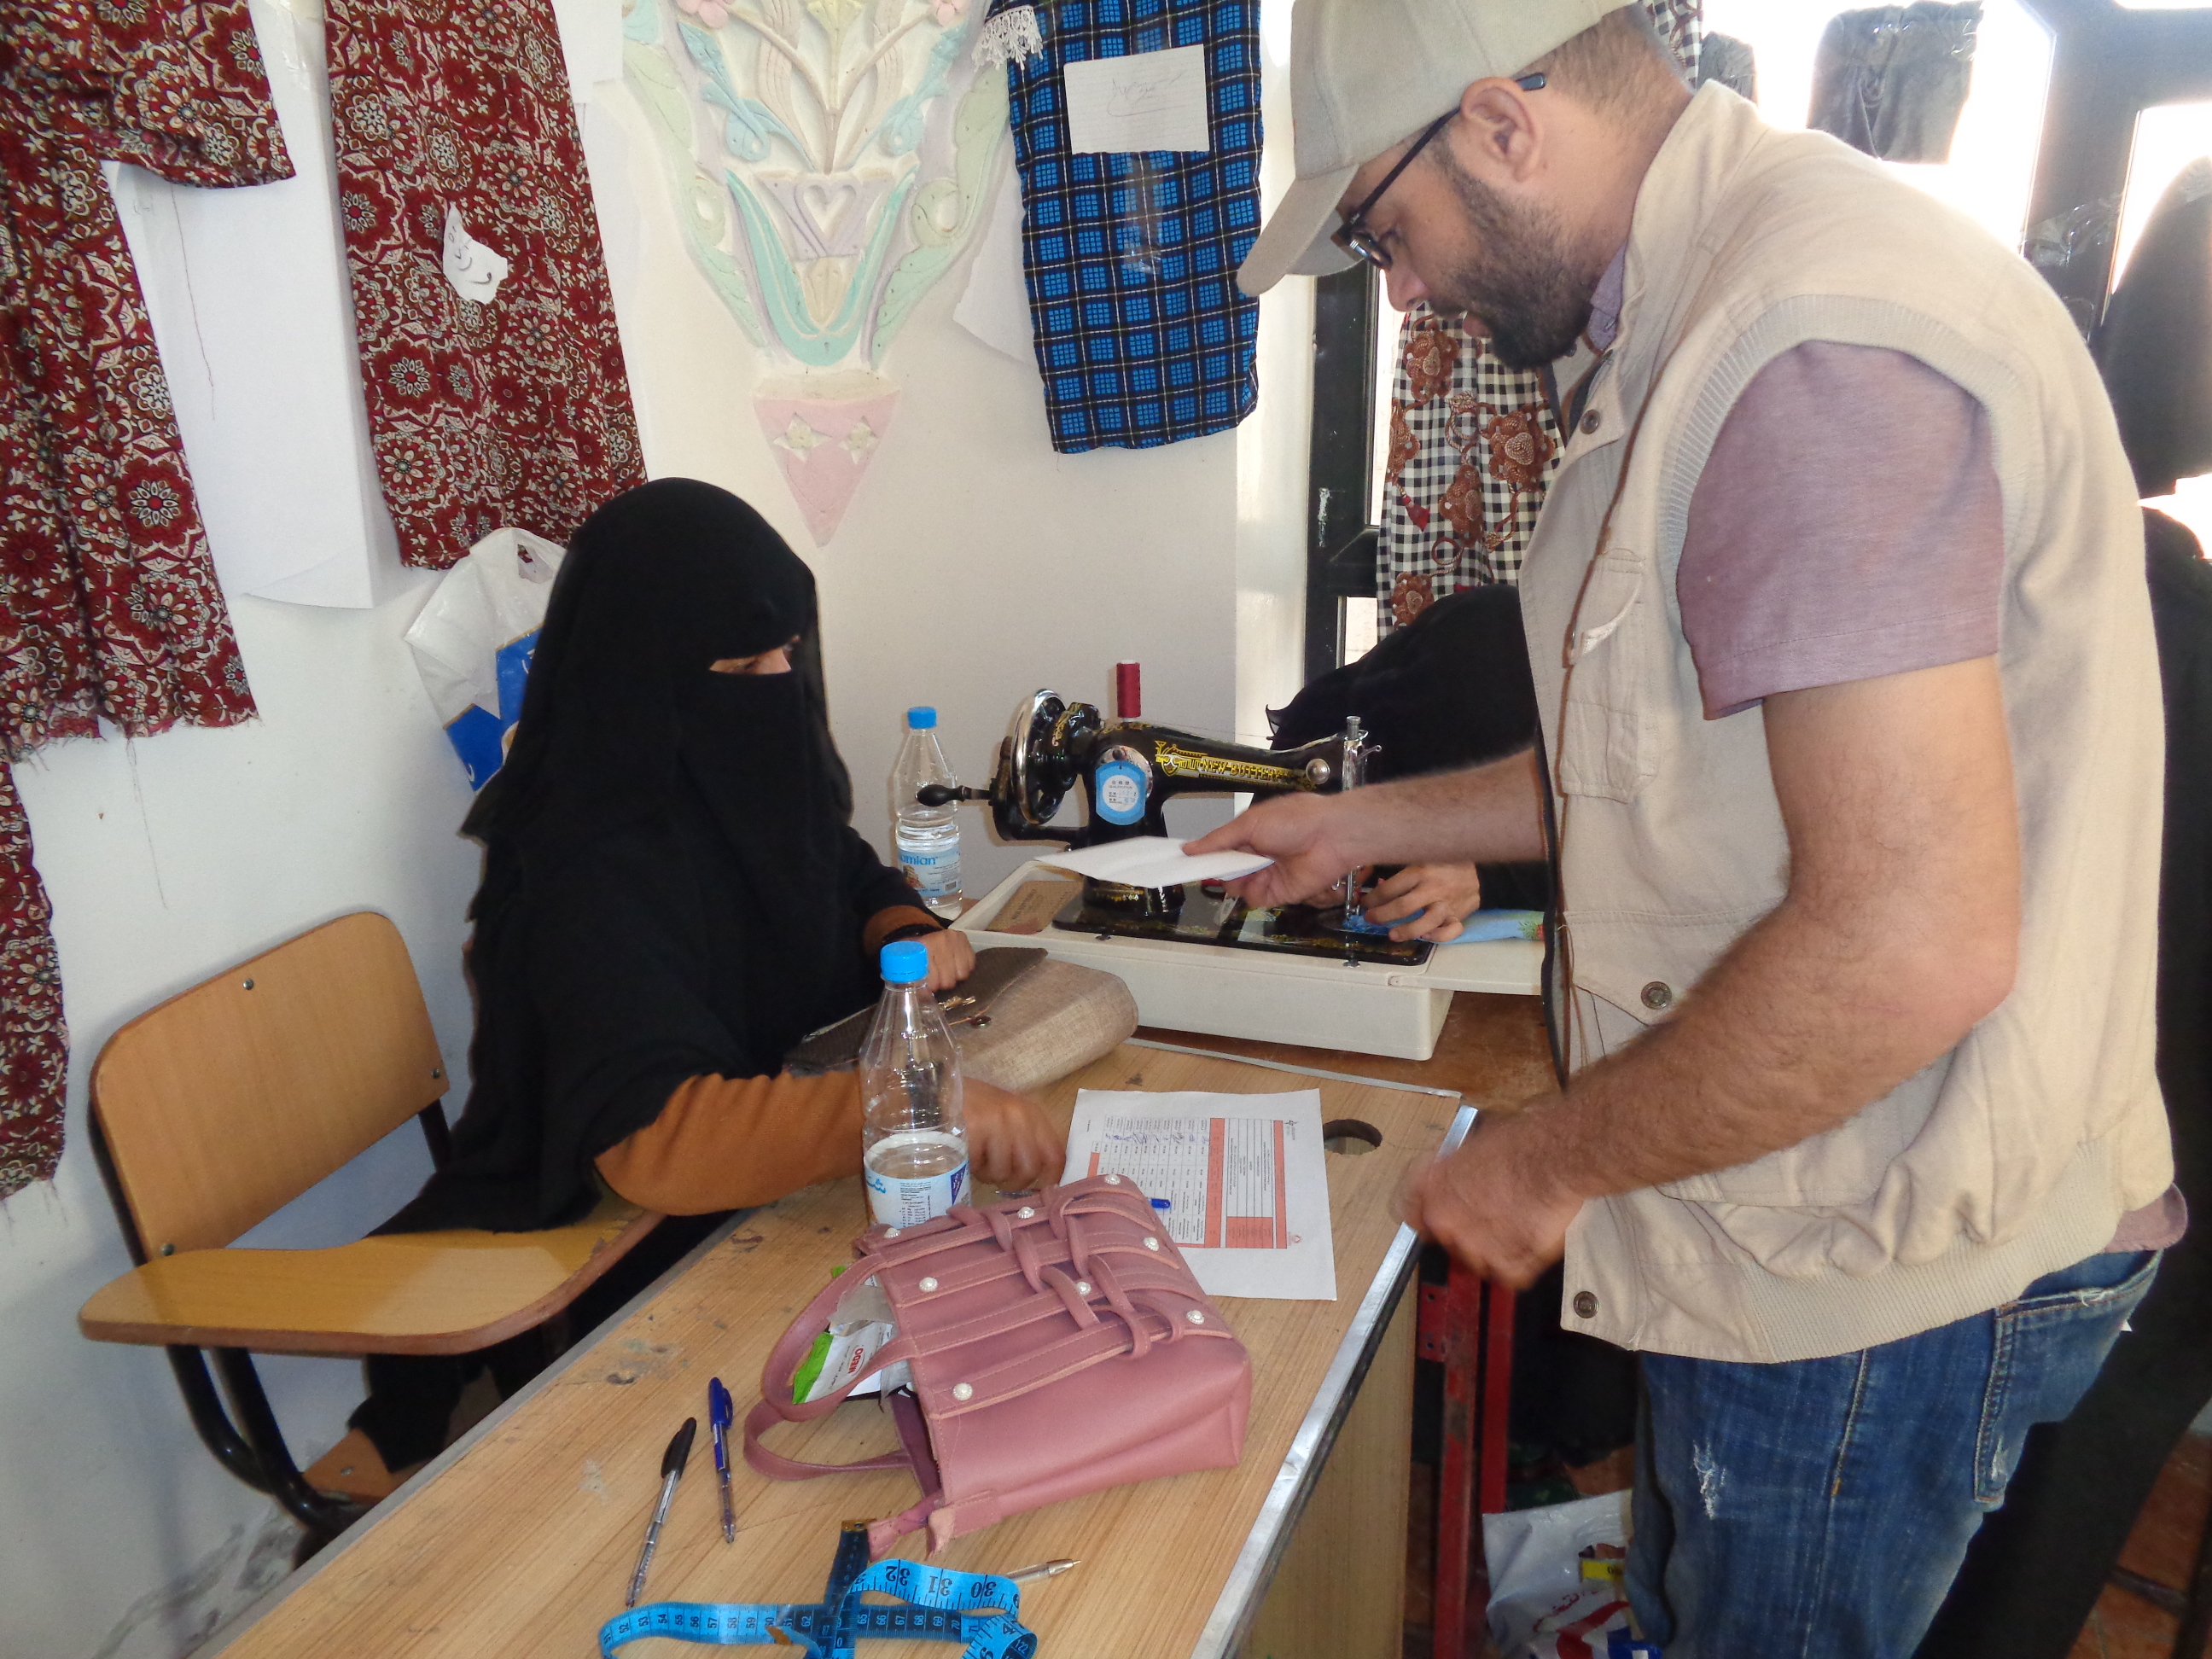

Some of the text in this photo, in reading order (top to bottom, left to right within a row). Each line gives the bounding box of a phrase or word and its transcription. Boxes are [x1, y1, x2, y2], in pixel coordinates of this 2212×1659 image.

[1201, 759, 1227, 775] NEW
[885, 1565, 911, 1586] 32
[928, 1575, 952, 1596] 31
[970, 1581, 997, 1598] 30
[620, 1622, 630, 1633] 52
[640, 1616, 649, 1627] 53
[658, 1614, 667, 1624] 54
[675, 1615, 683, 1626] 55
[690, 1615, 700, 1627] 56
[707, 1617, 718, 1628] 57
[727, 1617, 736, 1628] 58
[746, 1617, 756, 1628] 59
[801, 1615, 811, 1627] 62
[858, 1614, 868, 1625] 65
[876, 1615, 887, 1625] 66
[895, 1615, 905, 1626] 67
[914, 1615, 924, 1626] 68
[934, 1615, 943, 1627] 69
[952, 1619, 961, 1631] 70
